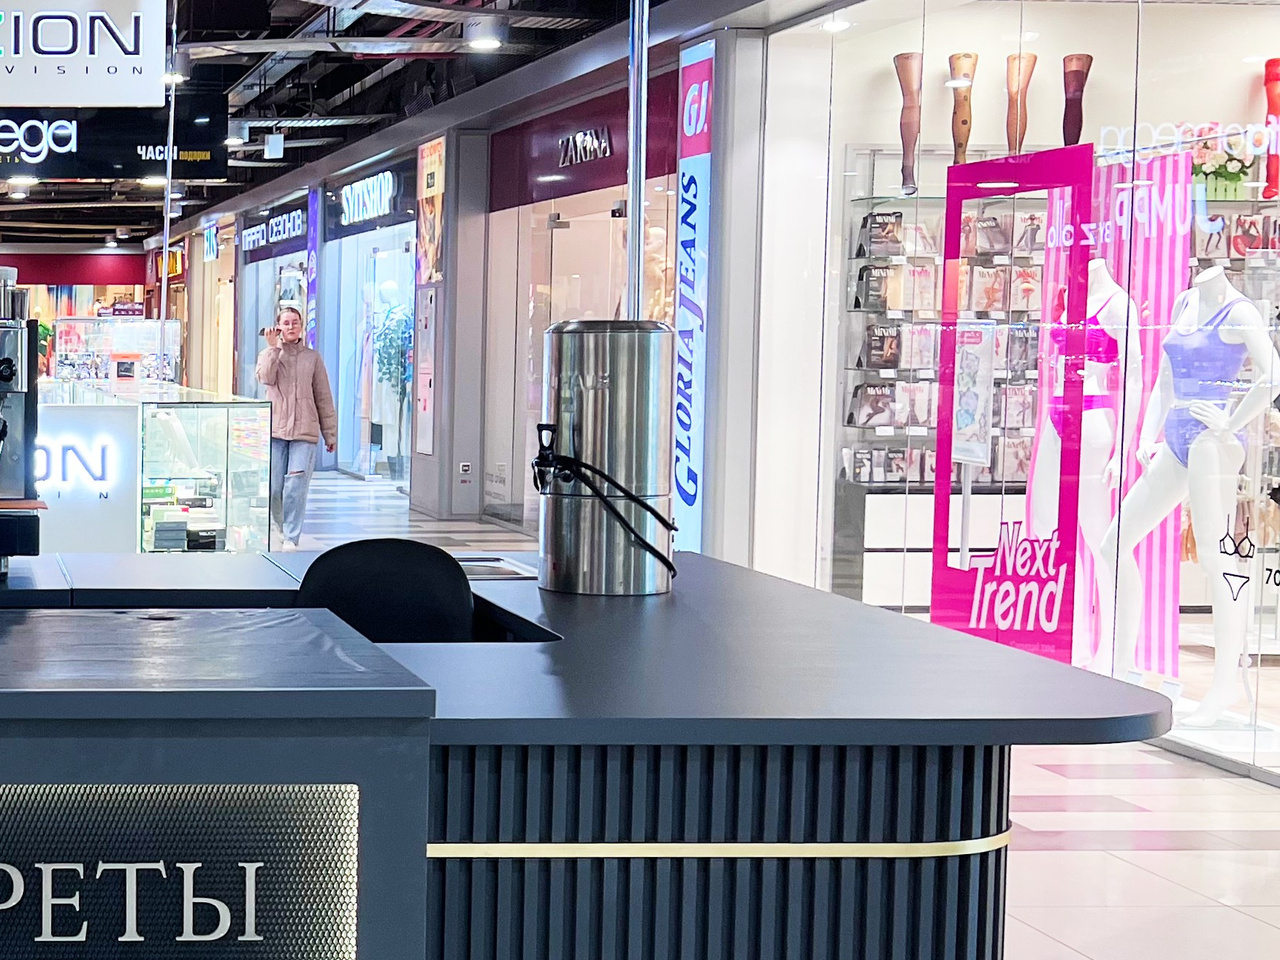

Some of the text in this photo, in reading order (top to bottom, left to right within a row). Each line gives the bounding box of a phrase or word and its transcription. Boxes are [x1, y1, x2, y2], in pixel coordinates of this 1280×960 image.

[5, 64, 143, 74] VISION
[675, 171, 704, 507] GLORIA JEANS
[994, 522, 1060, 579] Next
[969, 556, 1067, 633] Trend
